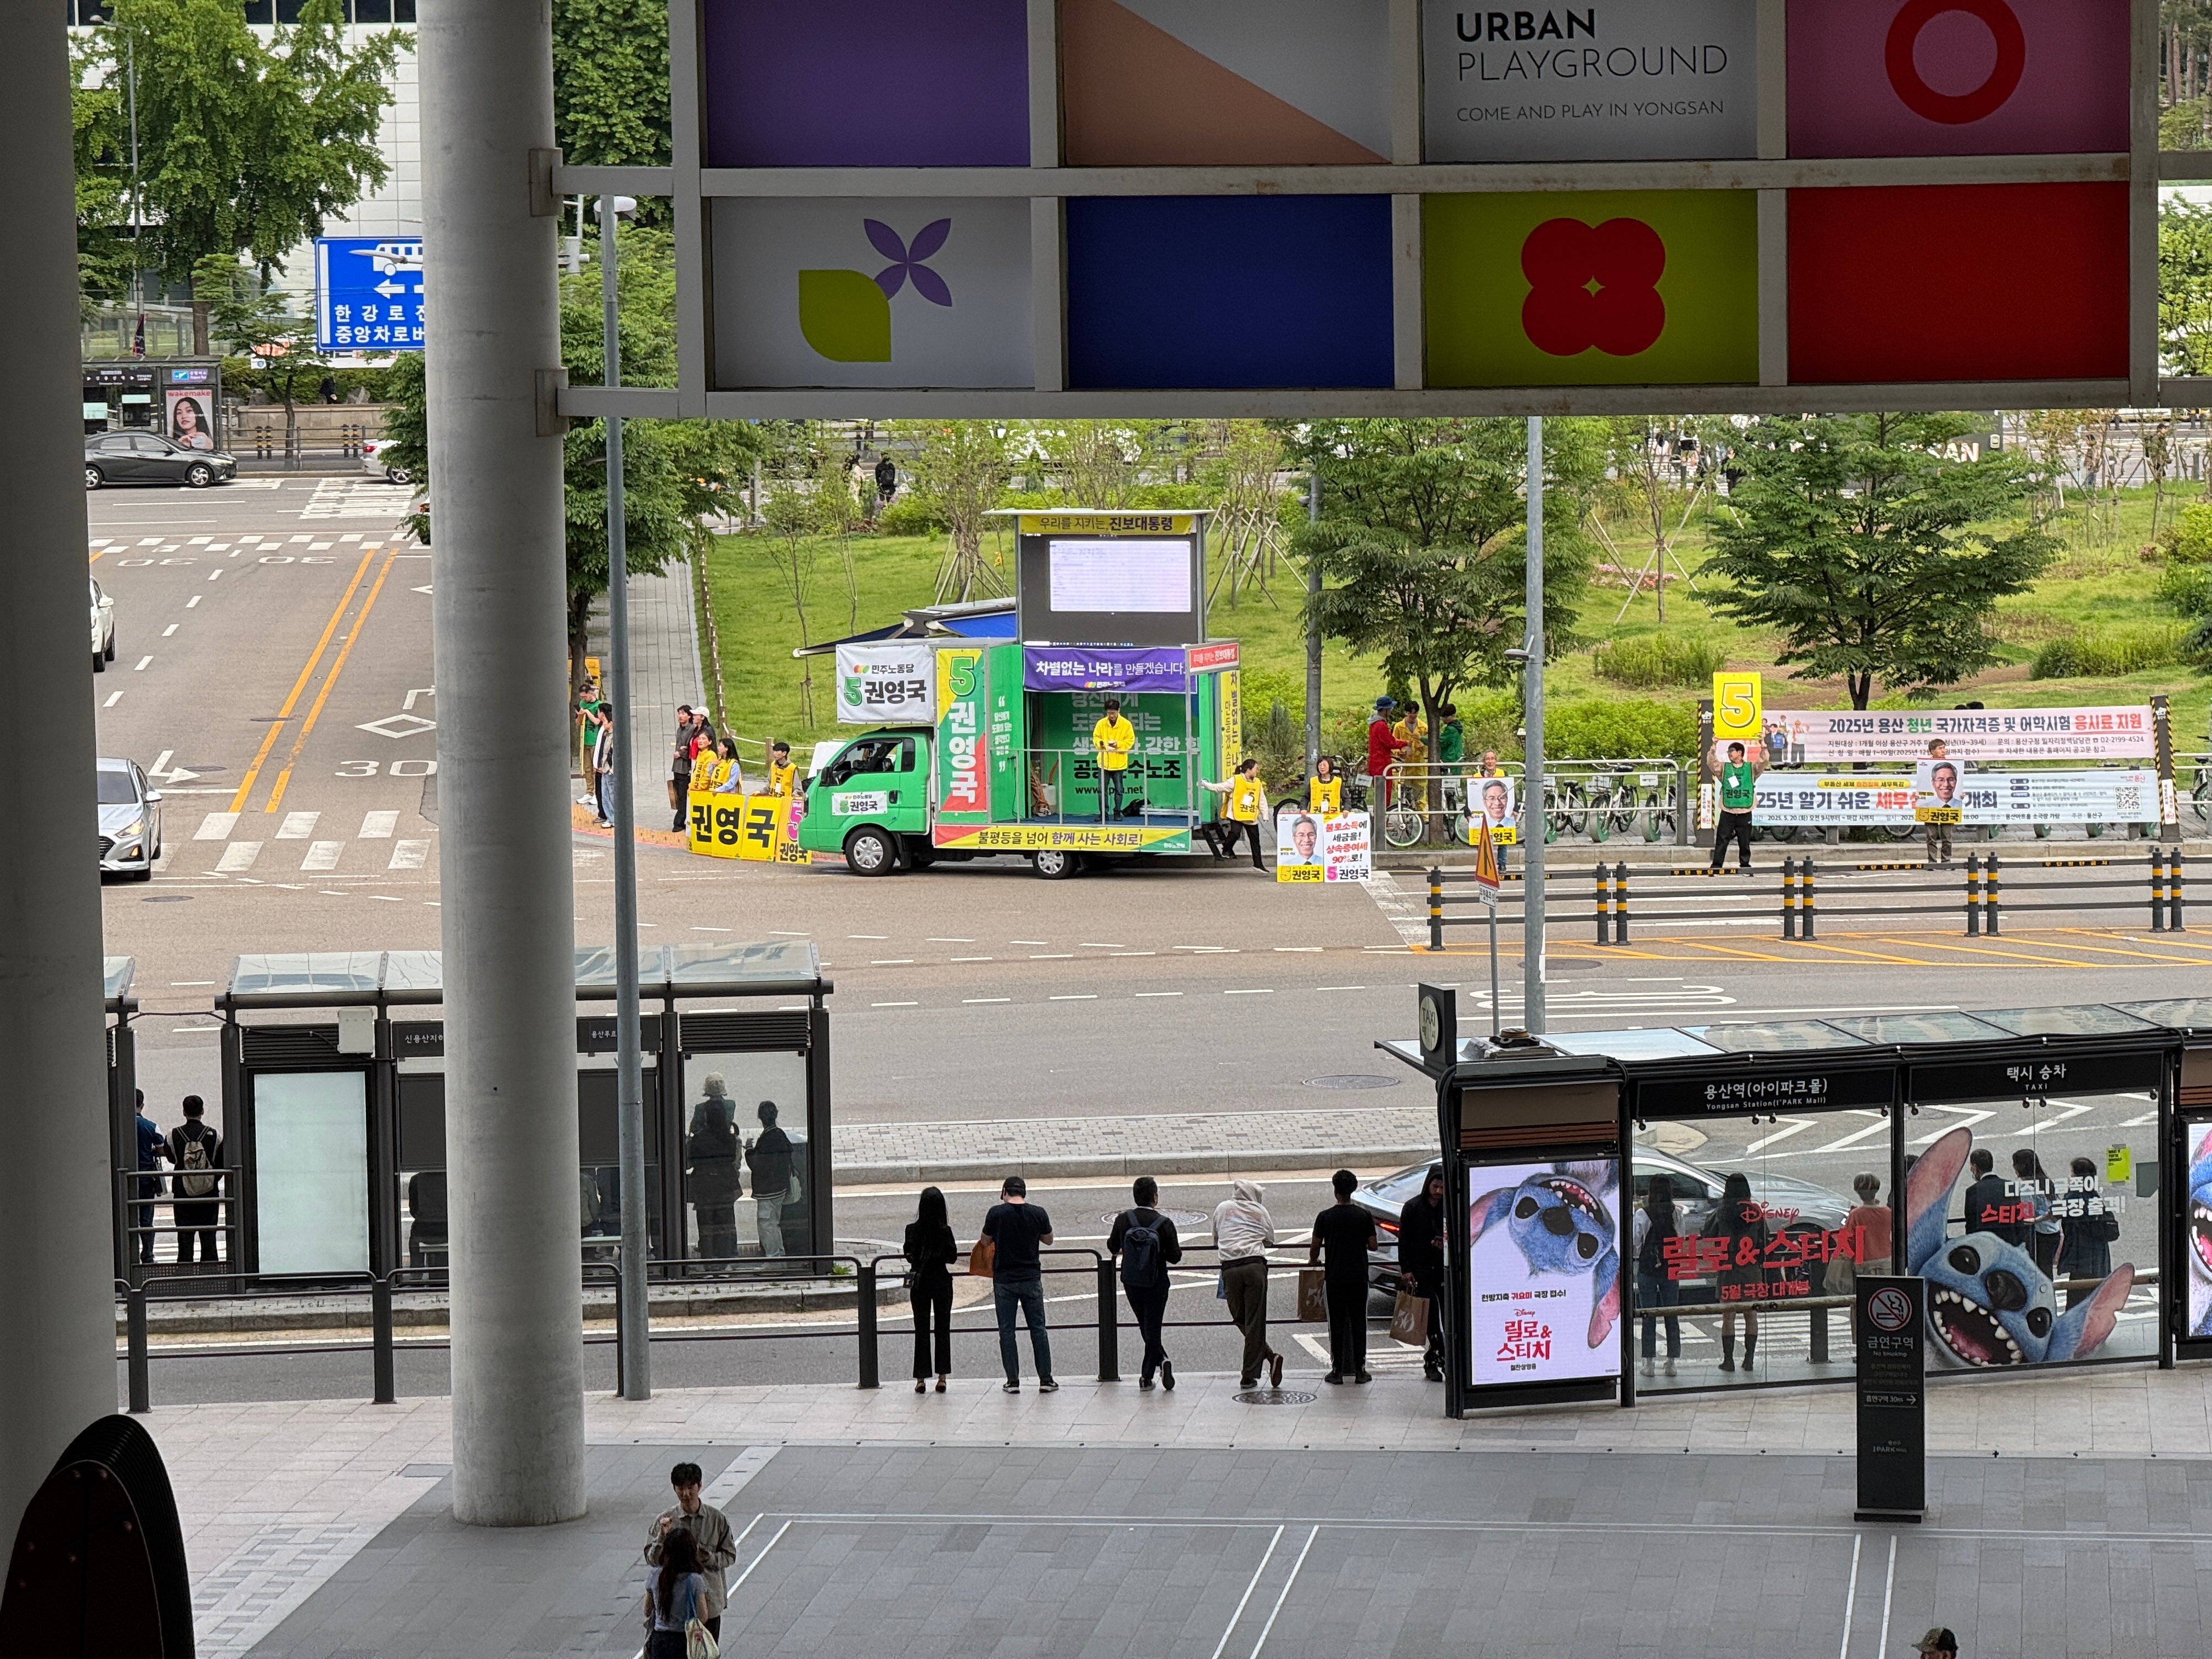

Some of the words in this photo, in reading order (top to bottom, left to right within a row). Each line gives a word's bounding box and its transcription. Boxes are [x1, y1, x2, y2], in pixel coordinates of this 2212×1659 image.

[1457, 9, 1595, 42] URBAN
[1459, 45, 1727, 81] PLAYGROUND
[1457, 107, 1510, 122] COME
[1516, 105, 1555, 120] AND
[1562, 104, 1603, 118] PLAY
[1610, 103, 1627, 117] IN
[1634, 100, 1724, 116] YONGSAN
[1040, 517, 1071, 530] 우리를
[1074, 517, 1107, 530] 지키는
[1109, 517, 1173, 531] 진보대통령
[872, 664, 915, 674] 민주노동당
[949, 656, 976, 697] 5
[1036, 661, 1085, 676] 차별없는
[1088, 662, 1122, 677] 나라를
[1126, 662, 1185, 676] 만들겠습니다.
[844, 676, 862, 706] 5
[865, 680, 927, 704] 권영국
[1720, 683, 1755, 728] 5
[1829, 718, 1874, 733] 2025년
[1878, 718, 1903, 733] 용산
[1906, 717, 1932, 733] 청년
[1936, 717, 2000, 732] 국가자격증
[2004, 716, 2016, 732] 및
[2020, 715, 2070, 731] 어학시험
[2075, 714, 2113, 730] 응시료
[2117, 713, 2142, 729] 지원
[949, 701, 978, 803] 권영국
[1146, 736, 1180, 755] 강한
[335, 760, 437, 777] 30
[839, 800, 849, 813] 5
[850, 800, 878, 812] 권영국
[1756, 792, 1793, 809] 25년
[1798, 792, 1832, 809] 알기
[1838, 791, 1870, 809] 쉬운
[1964, 791, 1997, 809] 개최
[787, 799, 804, 842] 5
[1930, 811, 1959, 821] 권영국
[692, 804, 776, 848] 권영국
[1325, 820, 1368, 833] 불로소득에
[978, 831, 1023, 844] 불평등을
[1027, 832, 1048, 844] 넘어
[1052, 832, 1075, 845] 함께
[1077, 834, 1101, 845] 사는
[1104, 833, 1142, 846] 사회로!
[1333, 832, 1361, 842] 세금을!
[1491, 832, 1513, 842] 영국
[780, 843, 808, 863] 권영국
[1326, 842, 1368, 854] 상속증여세
[1332, 853, 1363, 864] 90%로!
[1280, 866, 1291, 881] 5
[1292, 870, 1321, 881] 권영국
[1327, 866, 1338, 881] 5
[1339, 868, 1369, 881] 권영국
[1422, 1007, 1436, 1027] TAXI
[2007, 1065, 2032, 1082] 택시
[2039, 1063, 2067, 1080] 승차
[1704, 1077, 1827, 1100] 용산역(아이파크몰)
[2025, 1082, 2047, 1091] TAXI
[1706, 1102, 1739, 1110] Yongsan
[1806, 1096, 1826, 1104] Mall)
[2004, 1178, 2050, 1198] 디즈니
[1980, 1202, 2036, 1224] 스티치
[2051, 1198, 2085, 1217] 극장
[2087, 1195, 2126, 1216] 출격!
[1481, 1293, 1509, 1302] 천방지축
[1511, 1291, 1532, 1300] 귀요미
[1534, 1290, 1548, 1299] 극장
[1550, 1289, 1566, 1298] 접수!
[1722, 1285, 1741, 1300] 5월
[1744, 1283, 1769, 1297] 극장
[1773, 1280, 1809, 1296] 대개봉
[1497, 1340, 1551, 1362] 스티치
[1867, 1336, 1914, 1350] 금연구역
